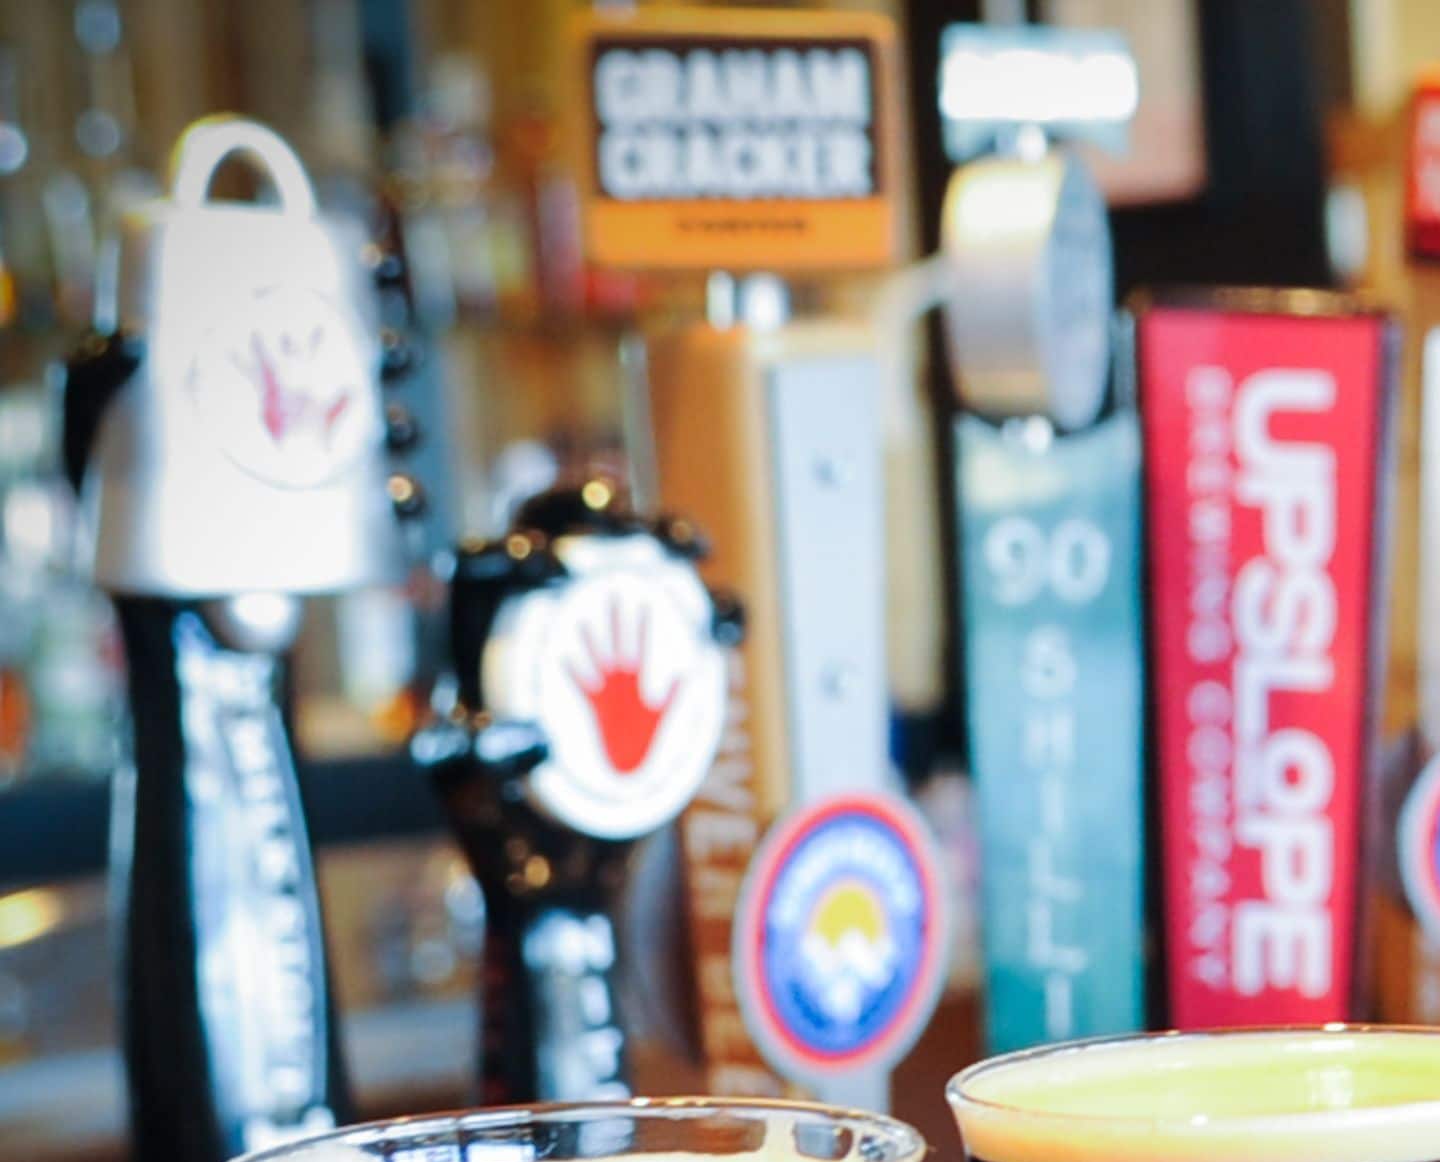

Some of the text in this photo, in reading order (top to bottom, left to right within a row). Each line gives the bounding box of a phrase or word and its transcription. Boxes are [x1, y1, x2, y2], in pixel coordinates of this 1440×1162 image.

[596, 49, 871, 121] GRAHAM
[600, 130, 872, 199] CRACKER
[984, 516, 1108, 605] 90
[1232, 366, 1338, 997] UPSLOPE
